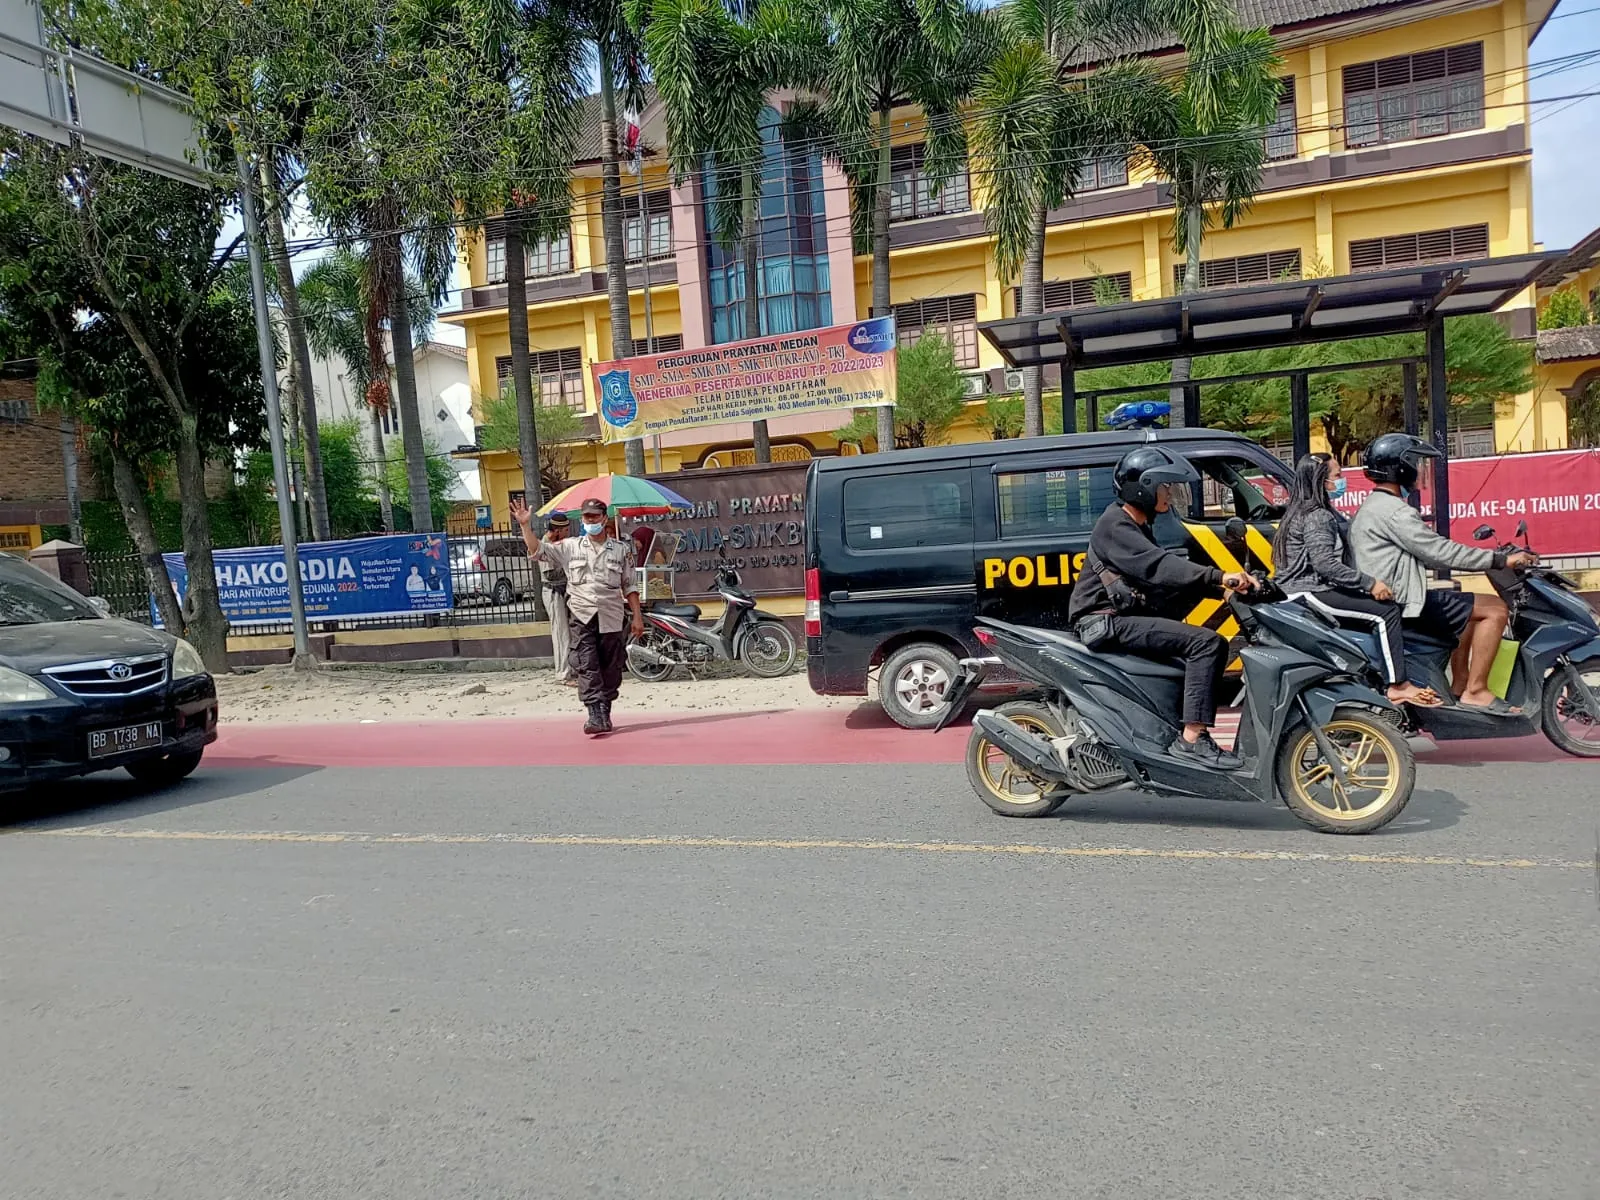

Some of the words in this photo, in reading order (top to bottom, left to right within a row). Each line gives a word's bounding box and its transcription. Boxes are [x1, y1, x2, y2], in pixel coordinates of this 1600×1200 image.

[634, 373, 656, 388] SMP
[663, 370, 684, 385] SMA
[691, 365, 713, 380] SMK
[715, 362, 731, 375] BM
[738, 357, 761, 373] SMK
[827, 345, 846, 360] TKJ
[657, 350, 720, 369] PERGURUAN
[723, 343, 778, 360] PRAYATNA
[780, 336, 818, 351] MEDAN
[636, 384, 692, 402] MENERIMA
[694, 376, 742, 394] PESERTA
[745, 371, 775, 387] DIDIK
[778, 367, 807, 382] BARU
[810, 365, 828, 377] T.P.
[831, 356, 884, 374] 2022/2023
[695, 393, 721, 405] TELAH
[725, 388, 758, 401] DIBUKA
[761, 378, 826, 396] PENDAFTARAN
[644, 420, 668, 430] Tempat
[669, 413, 709, 426] Pendaftaran
[721, 409, 740, 419] Letda
[764, 404, 775, 413] No.
[777, 401, 791, 411] 403
[792, 398, 816, 408] Medan
[817, 397, 833, 407] Telp.
[681, 405, 705, 416] SETIAP
[706, 402, 725, 411] HARI
[748, 397, 772, 407] PUKUL
[827, 386, 843, 395] WIB
[730, 493, 804, 516] PRAYATN
[1481, 498, 1526, 517] KE-94
[1530, 494, 1579, 514] TAHUN
[214, 556, 357, 587] HAKORDIA
[984, 552, 1088, 589] POLIS
[218, 588, 237, 600] HARI
[239, 586, 290, 599] ANTIKORUPS
[302, 583, 336, 594] EDUNIA
[337, 581, 357, 593] 2022
[93, 733, 107, 748] BB
[114, 727, 138, 744] 1738
[146, 724, 159, 739] NA
